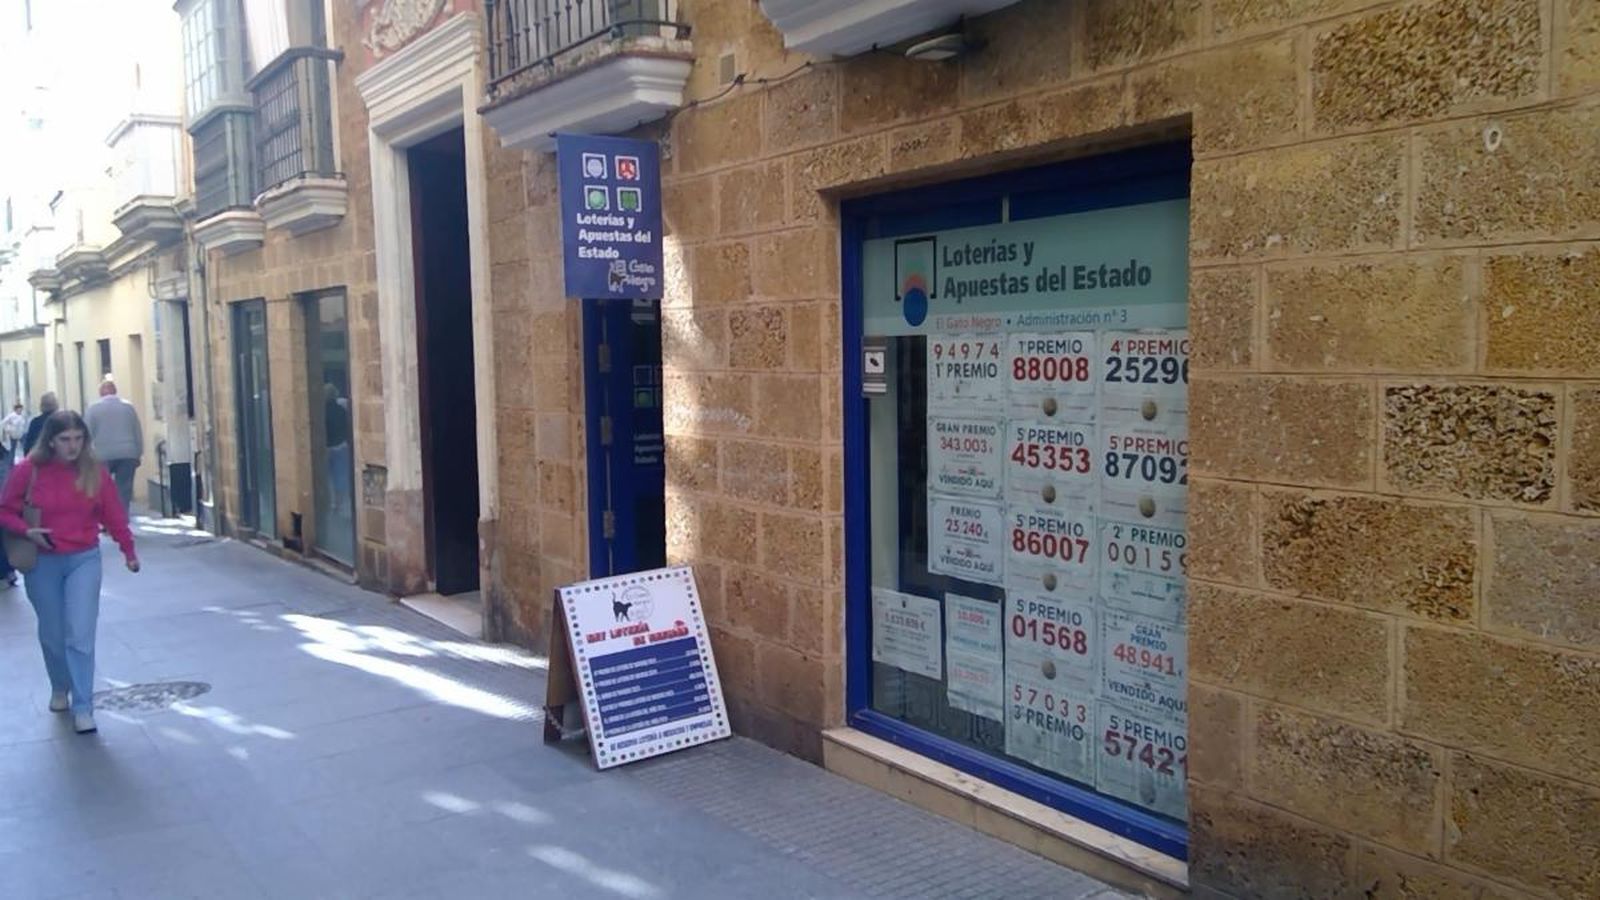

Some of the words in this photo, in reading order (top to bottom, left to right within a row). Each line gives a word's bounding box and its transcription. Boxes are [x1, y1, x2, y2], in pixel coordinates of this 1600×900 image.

[577, 213, 625, 226] Loterías
[626, 217, 635, 228] y
[578, 229, 632, 243] Apuestas
[634, 231, 651, 243] del
[578, 246, 620, 259] Estado
[942, 238, 1017, 267] Loterías
[1023, 240, 1035, 265] y
[943, 269, 1030, 303] Apuestas
[1035, 265, 1067, 292] del
[1073, 259, 1152, 290] Estado
[946, 315, 970, 330] Gato
[971, 313, 1002, 330] Negro
[1016, 308, 1101, 327] Administración
[1119, 308, 1128, 323] 3
[1028, 339, 1082, 354] PREMIO
[947, 363, 998, 379] PREMIO
[1013, 357, 1089, 382] 88008
[936, 422, 960, 433] GRAN
[962, 424, 996, 436] PREMIO
[1028, 429, 1084, 447] PREMIO
[1011, 443, 1091, 474] 45353
[939, 474, 972, 487] VENDIDO
[1028, 516, 1084, 538] PREMIO
[1131, 527, 1186, 549] PREMIO
[1012, 528, 1089, 564] 86007
[1028, 601, 1082, 627] PREMIO
[1012, 614, 1087, 655] 01568
[1130, 634, 1168, 652] PREMIO
[1135, 624, 1162, 640] GRAN
[1108, 678, 1156, 704] VENDIDO
[1026, 708, 1084, 742] PREMIO
[1124, 718, 1187, 752] PREMIO
